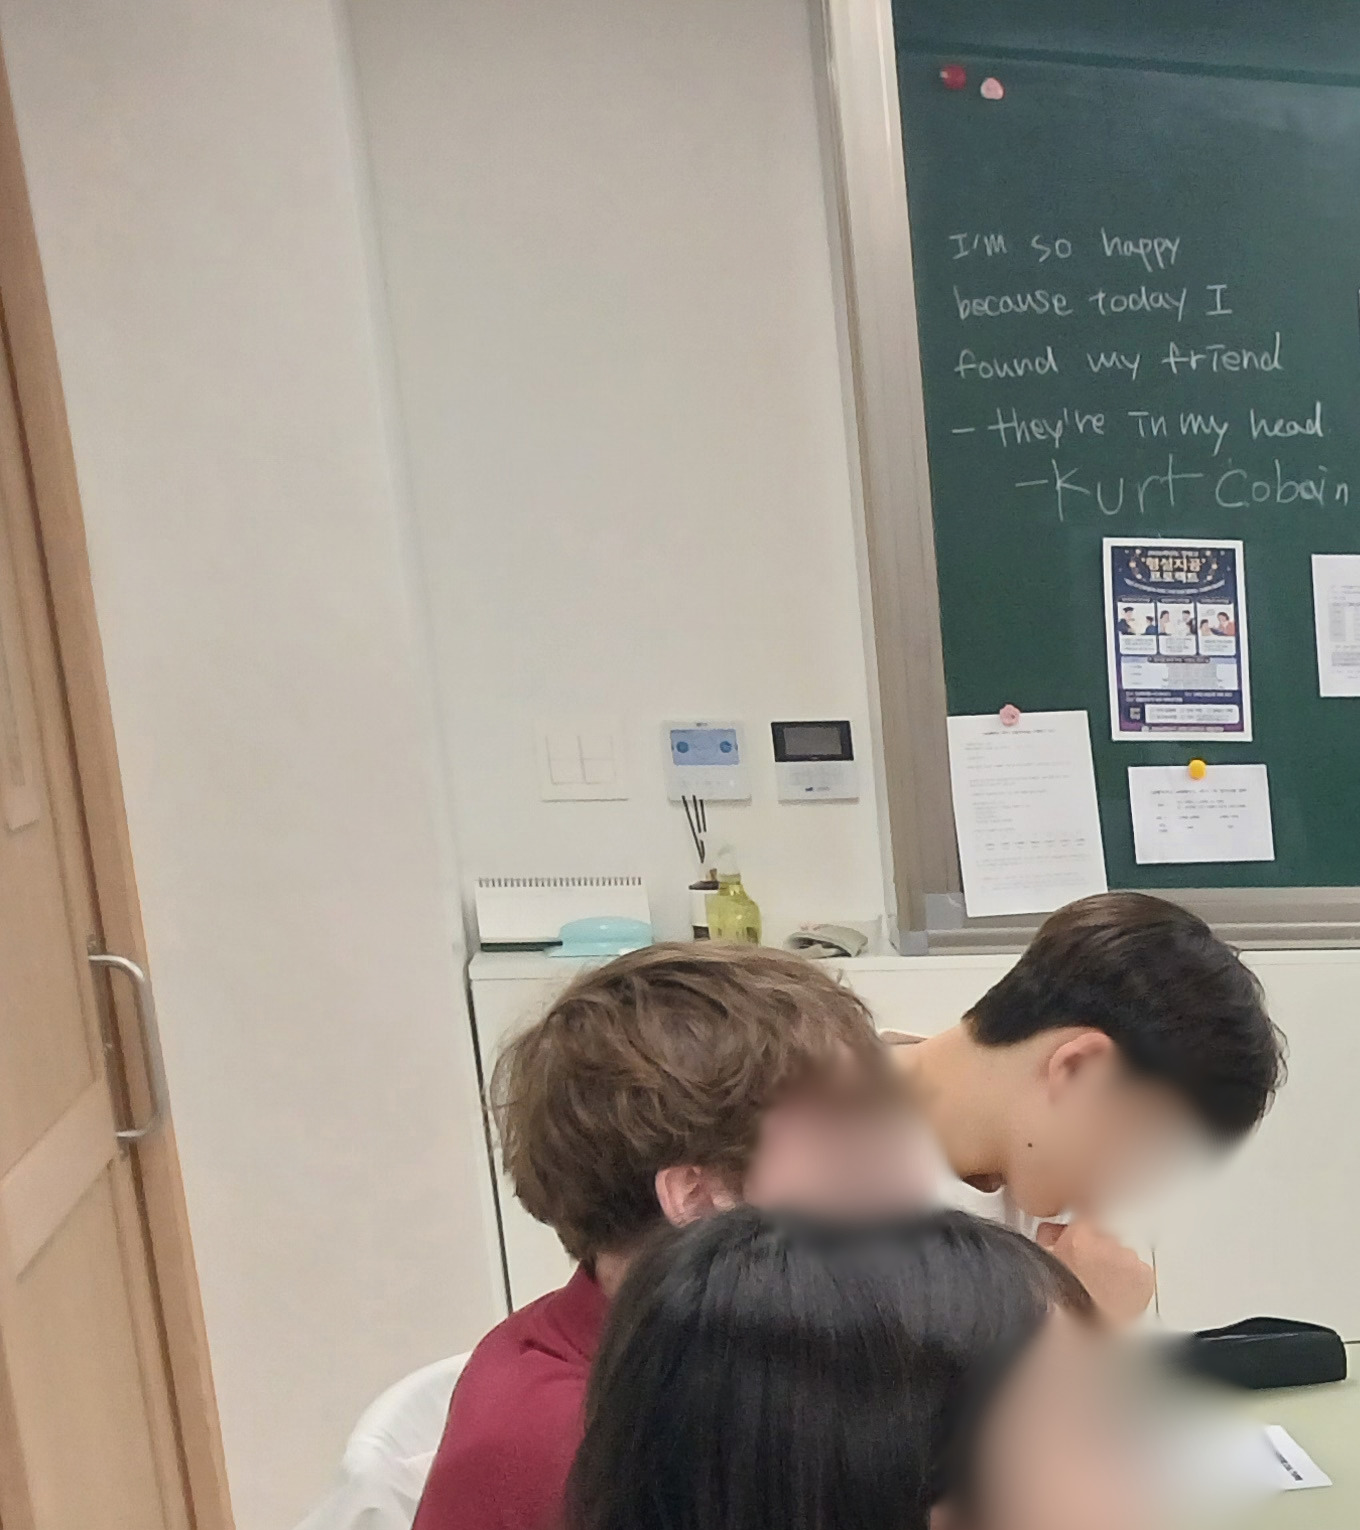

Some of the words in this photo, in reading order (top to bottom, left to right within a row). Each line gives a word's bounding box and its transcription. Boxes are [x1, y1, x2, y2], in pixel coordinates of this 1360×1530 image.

[1031, 235, 1072, 263] so
[1100, 227, 1180, 272] happy
[953, 285, 1074, 321] because
[1089, 286, 1187, 322] today
[1206, 284, 1233, 316] I
[954, 346, 1058, 379] found
[1086, 352, 1140, 381] my
[1161, 332, 1283, 376] friend
[988, 408, 1105, 448] they're
[1128, 410, 1168, 439] in
[1179, 415, 1229, 456] my
[1250, 401, 1322, 439] head
[1215, 457, 1349, 509] Cobain
